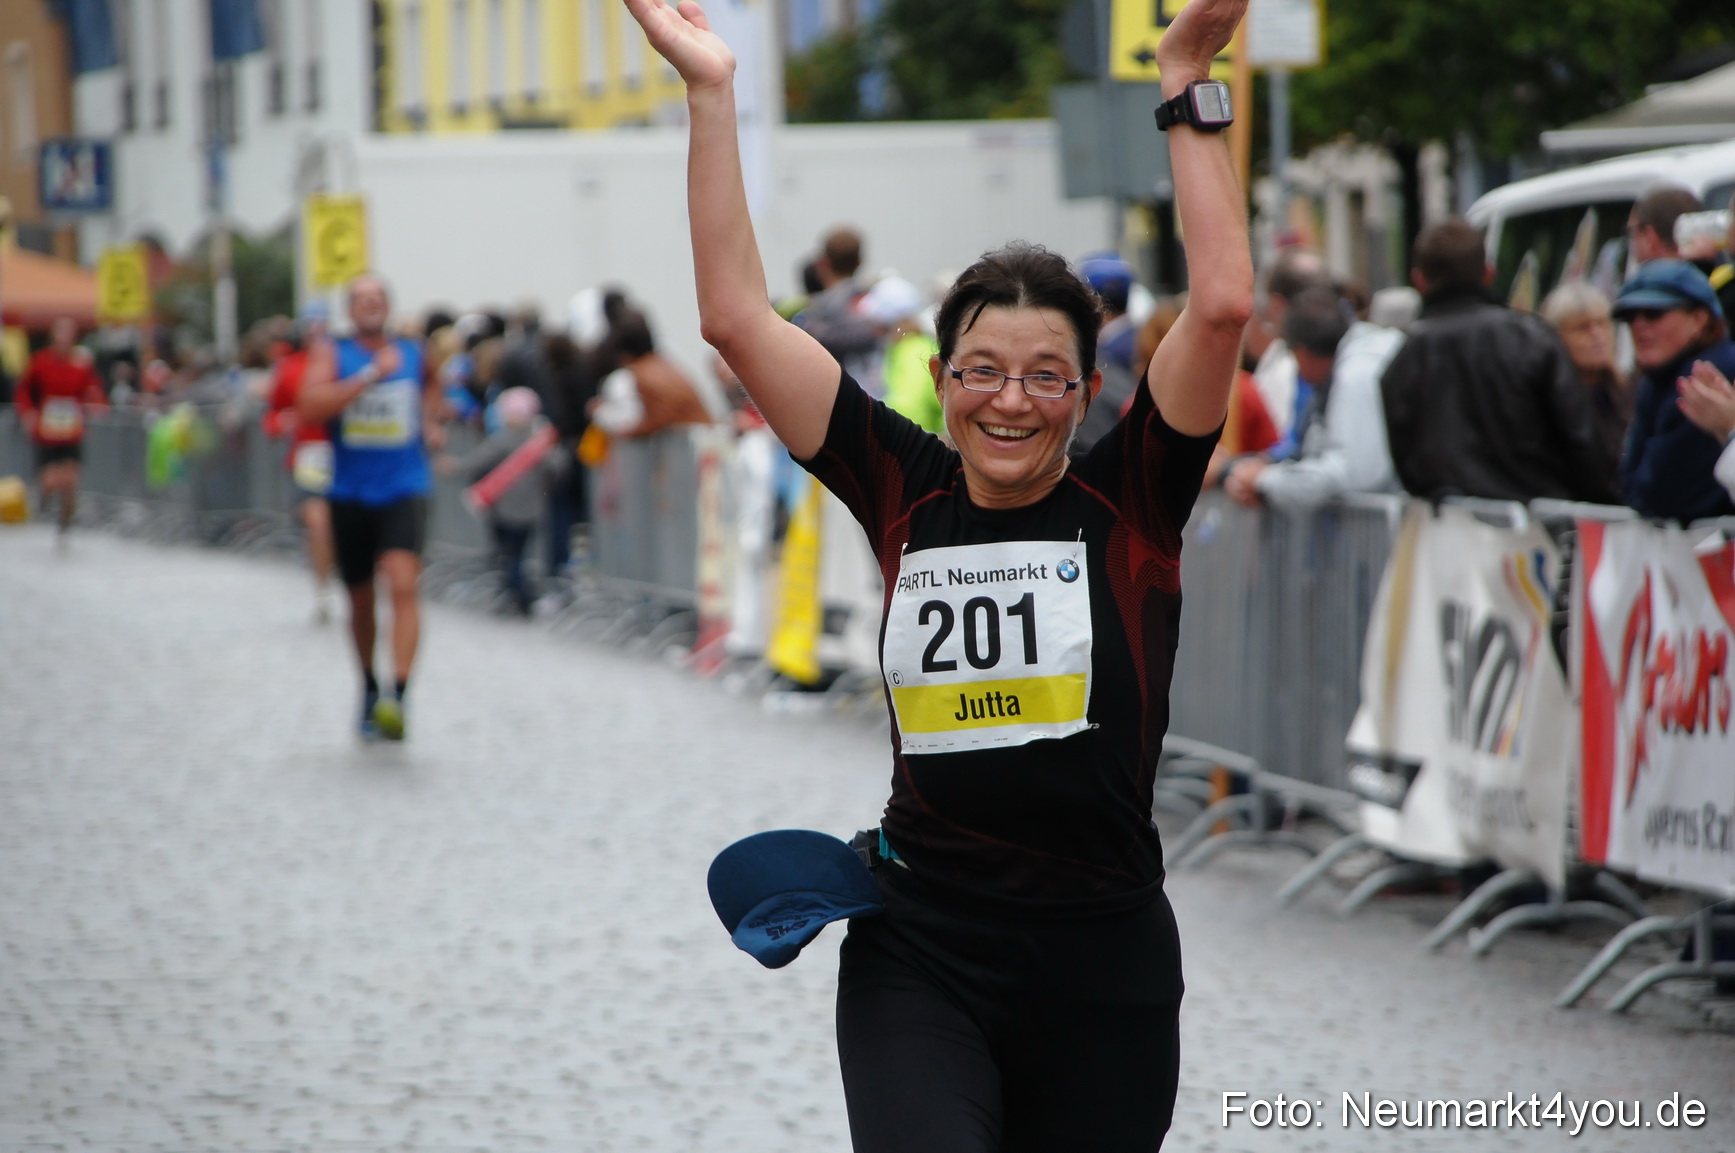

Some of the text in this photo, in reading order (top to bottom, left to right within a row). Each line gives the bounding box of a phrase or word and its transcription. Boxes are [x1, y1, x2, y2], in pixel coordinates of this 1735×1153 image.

[897, 563, 1048, 593] PARTL Neumarkt
[918, 592, 1038, 673] 201
[954, 691, 1021, 721] Jutta
